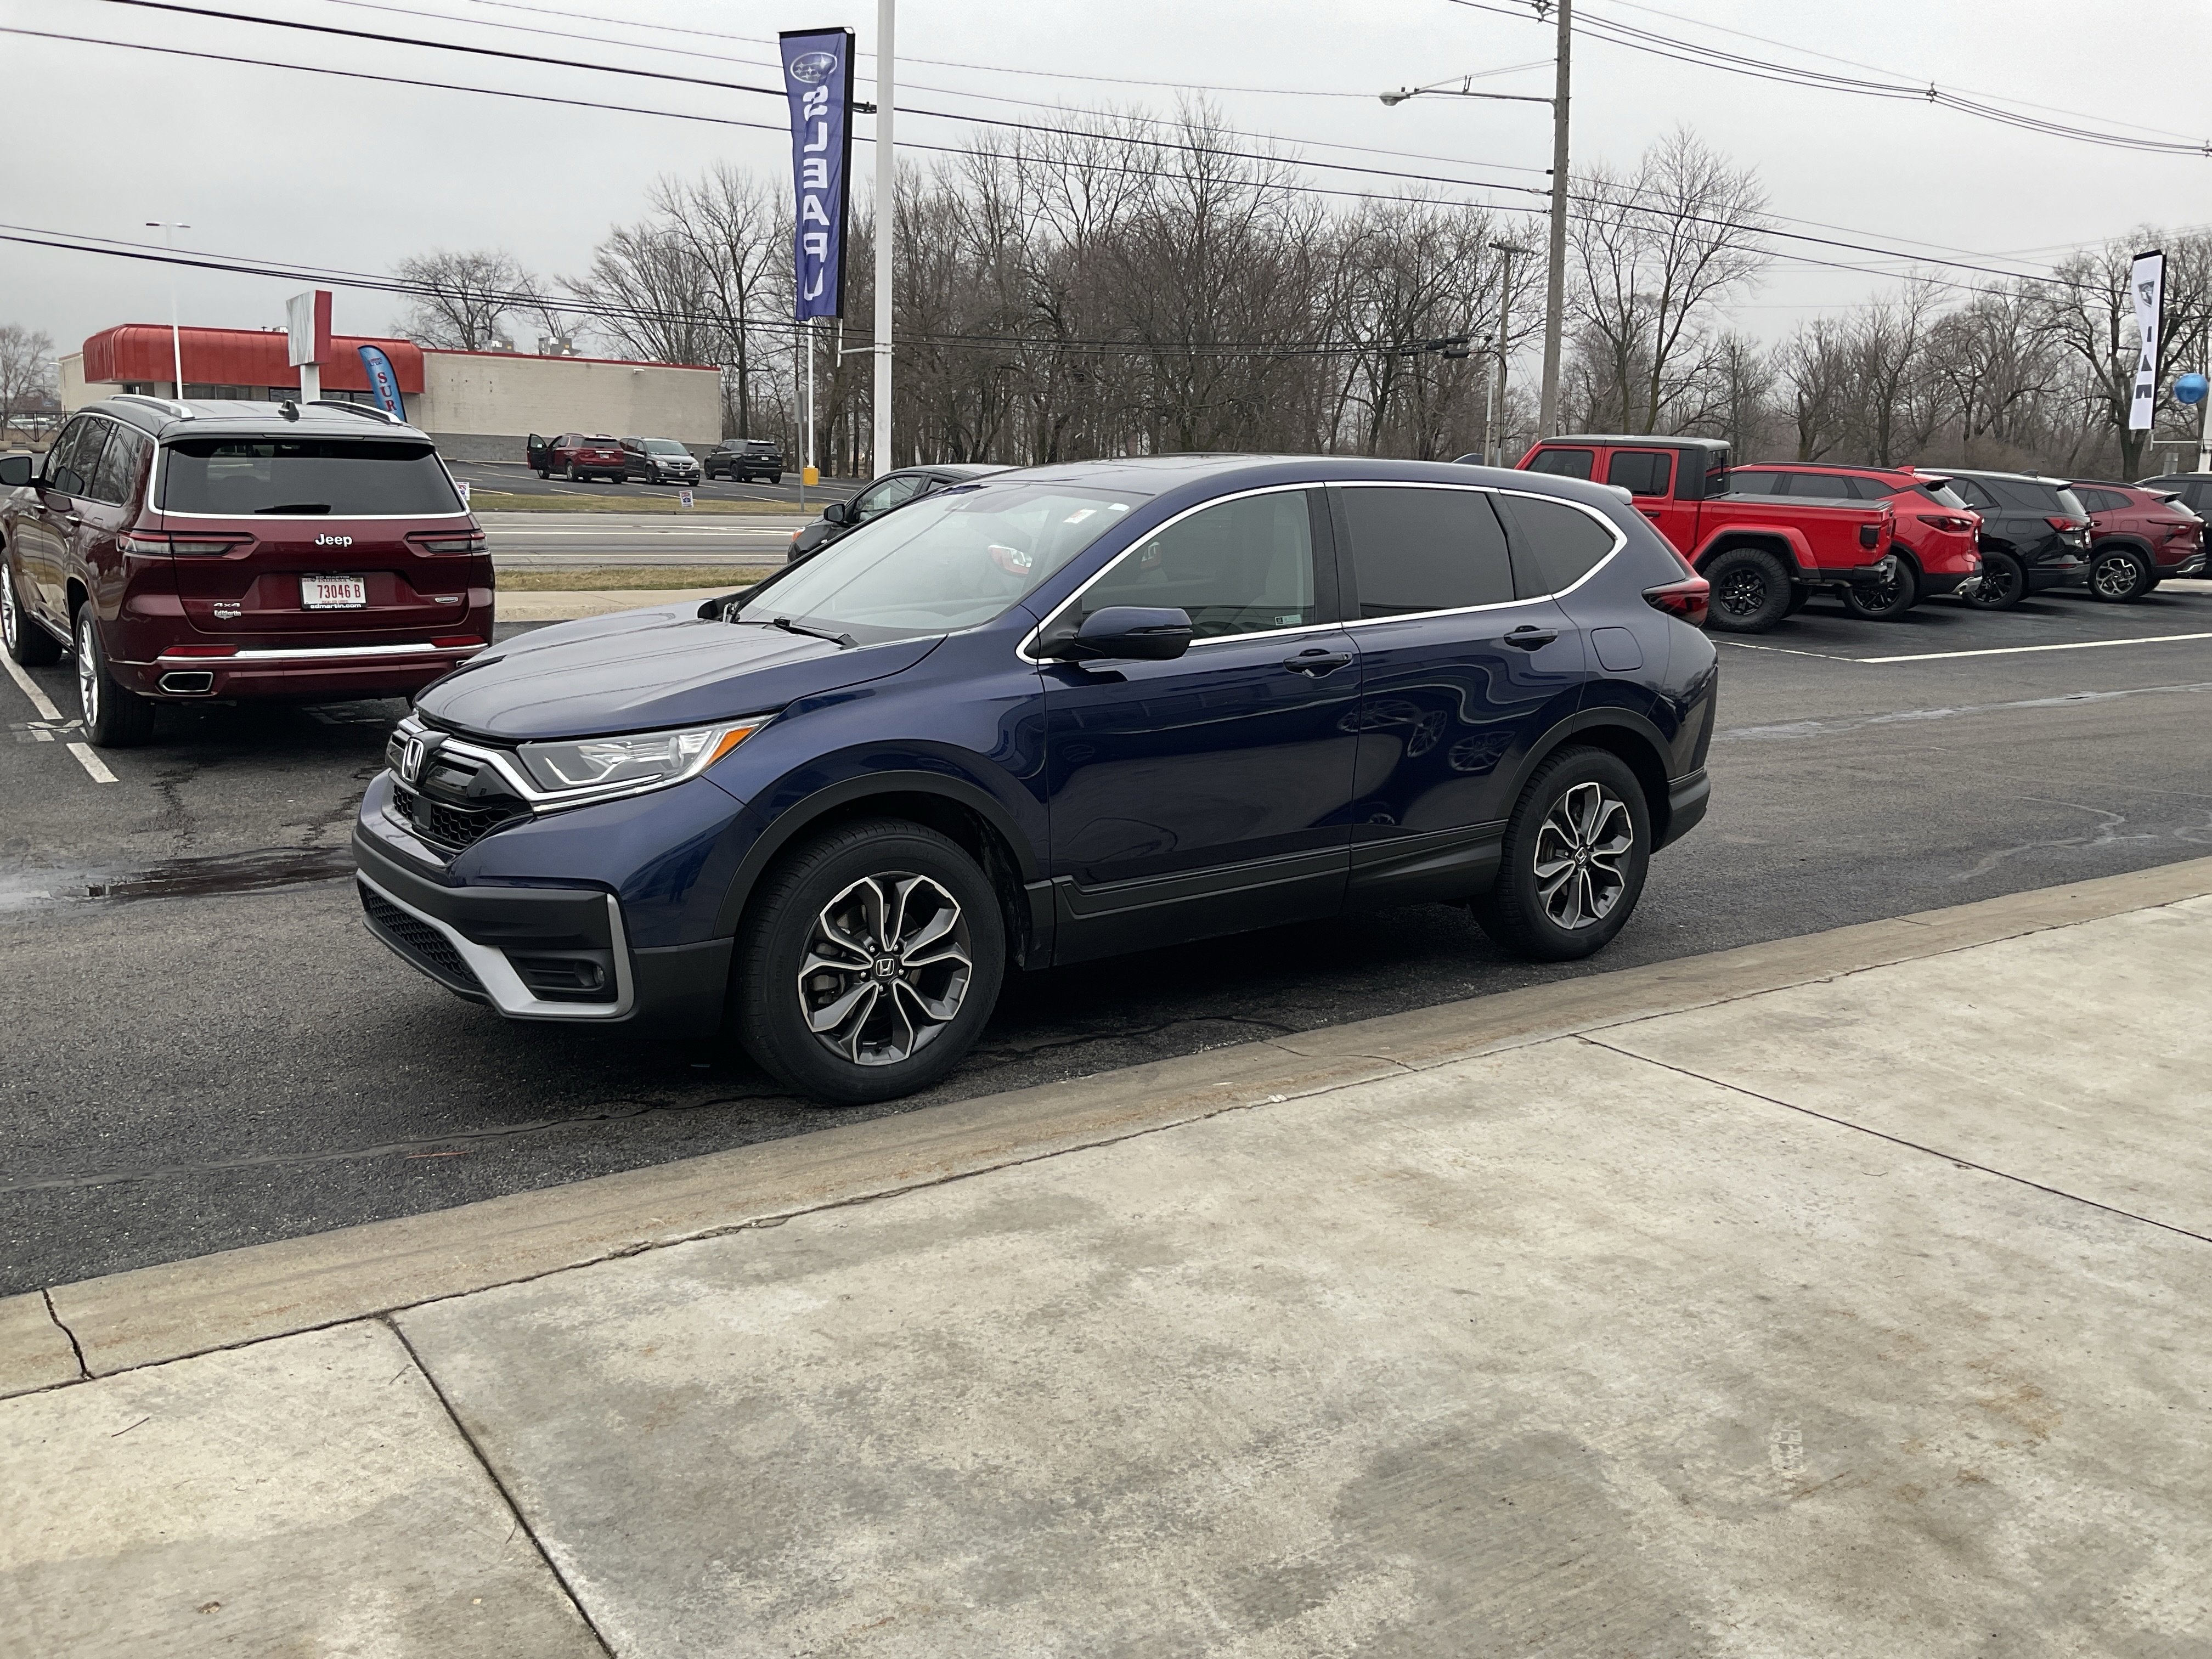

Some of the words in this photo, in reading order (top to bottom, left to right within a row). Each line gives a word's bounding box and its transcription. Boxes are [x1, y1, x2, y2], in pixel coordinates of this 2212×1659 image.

[315, 533, 352, 547] Jeep
[317, 585, 351, 599] 73046
[354, 584, 361, 598] B
